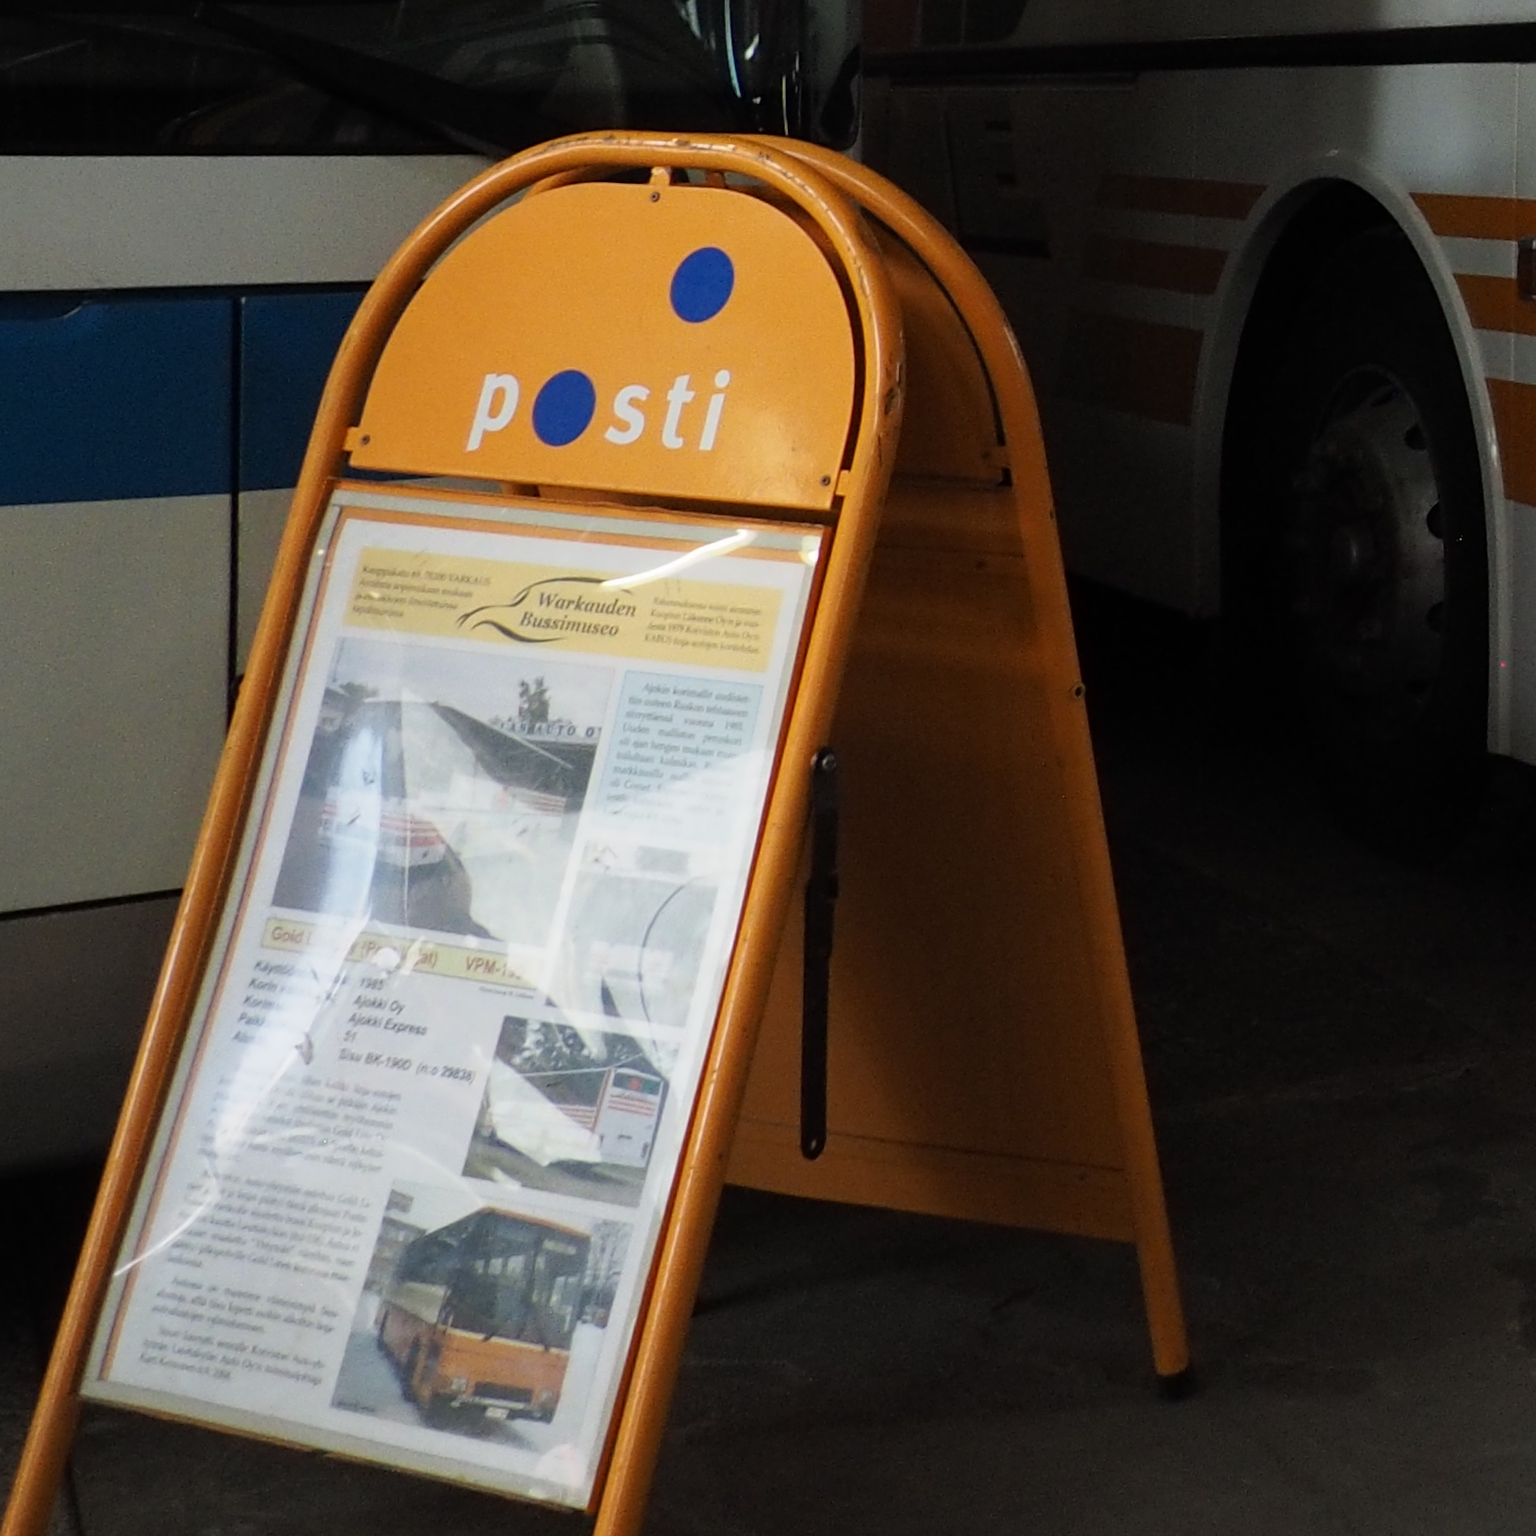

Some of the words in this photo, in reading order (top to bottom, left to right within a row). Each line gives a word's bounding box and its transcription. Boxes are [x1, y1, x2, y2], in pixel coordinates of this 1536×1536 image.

[466, 368, 731, 452] posti
[538, 591, 637, 619] Warkauden
[518, 611, 620, 637] Bussimuseo
[352, 993, 388, 1012] Ajokki
[389, 999, 405, 1014] Oy
[347, 1012, 384, 1030] Ajokki
[382, 1017, 429, 1037] Express
